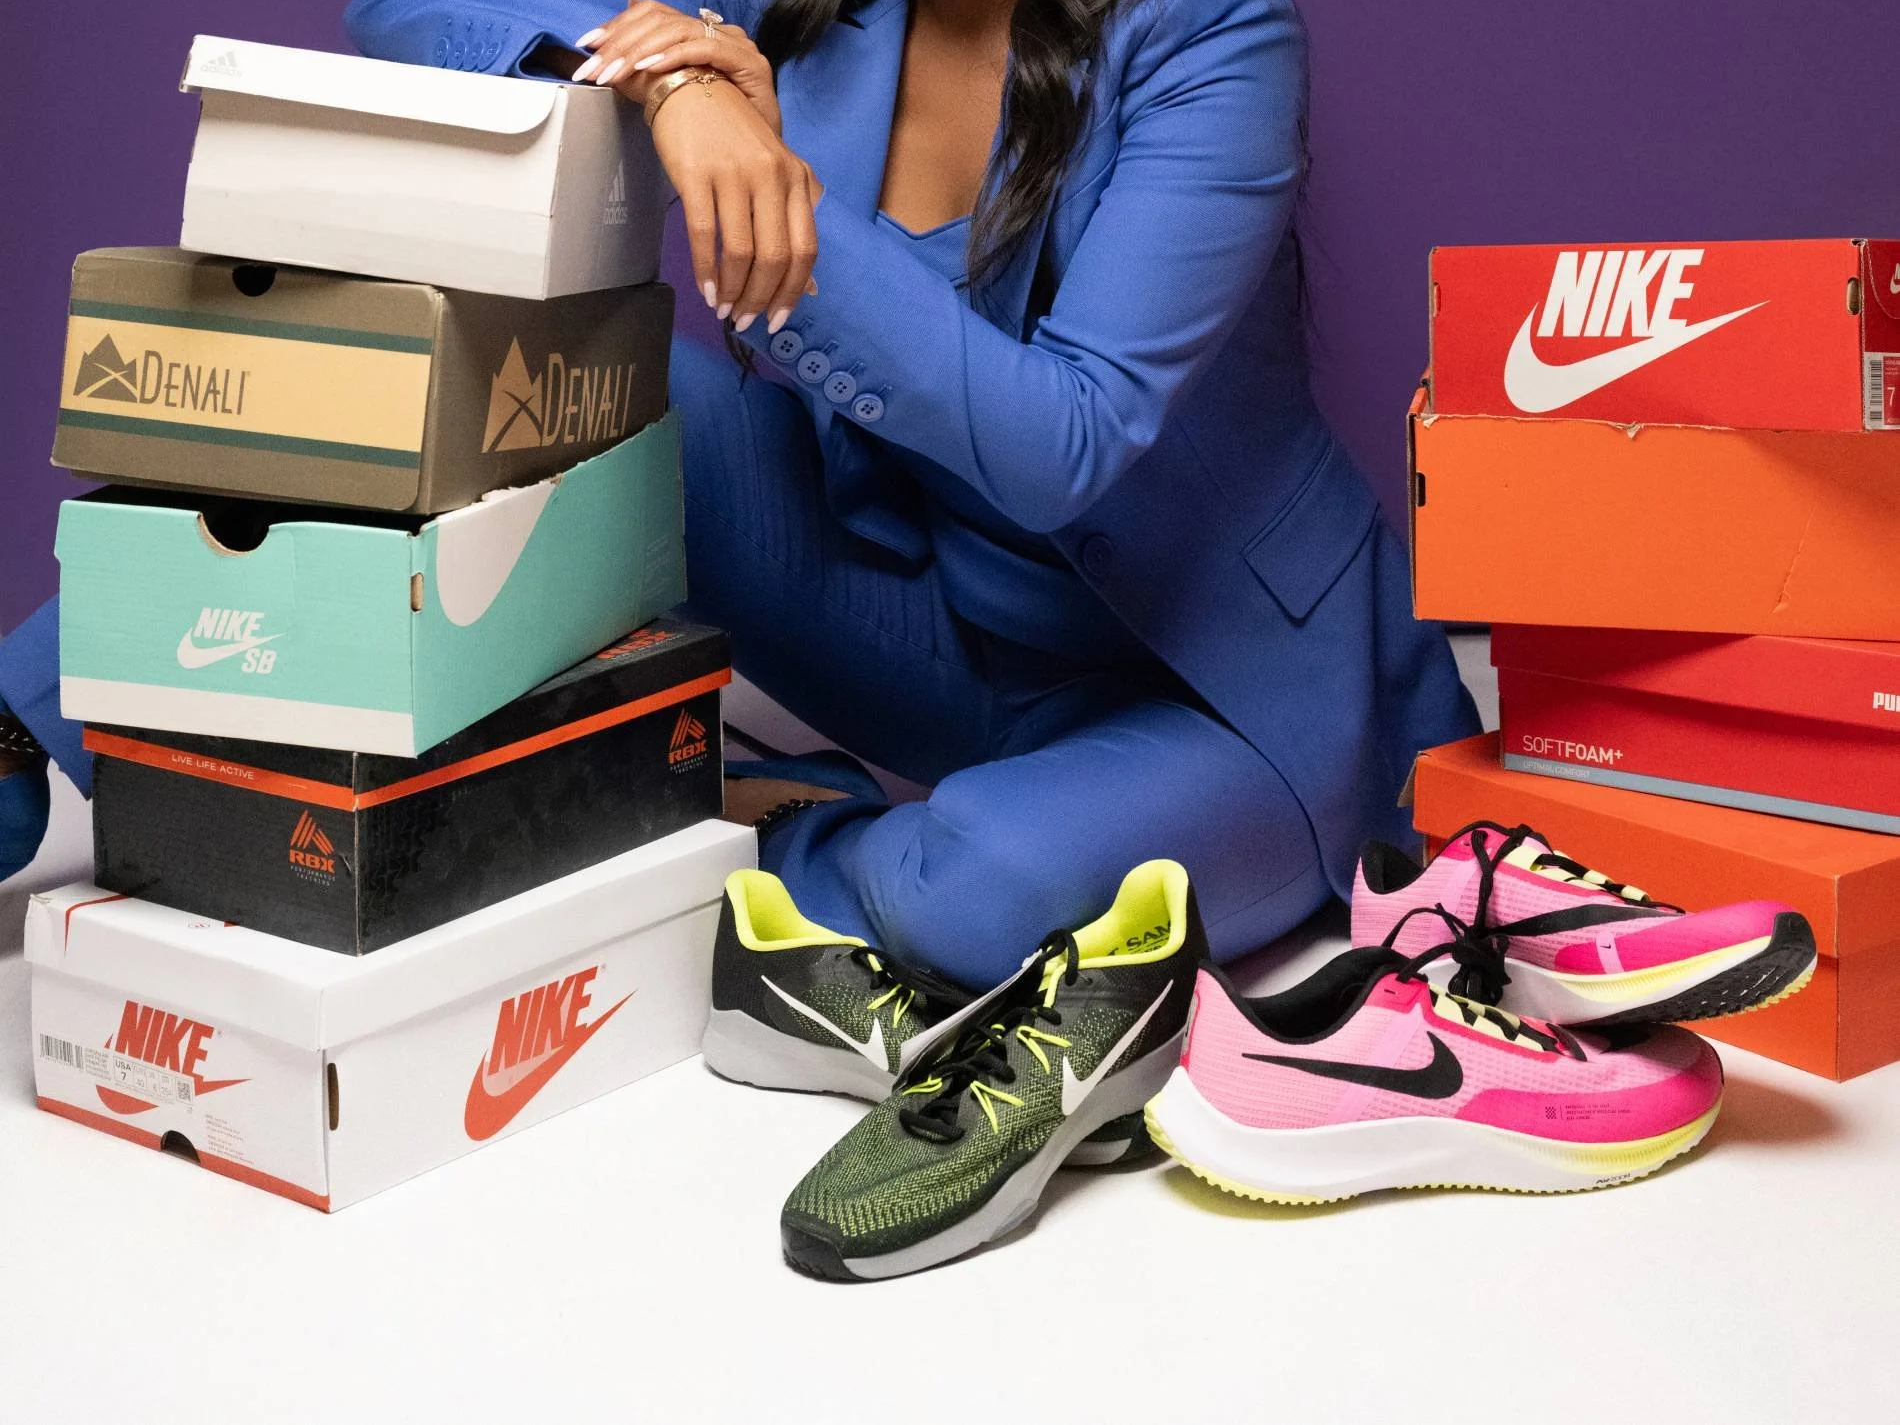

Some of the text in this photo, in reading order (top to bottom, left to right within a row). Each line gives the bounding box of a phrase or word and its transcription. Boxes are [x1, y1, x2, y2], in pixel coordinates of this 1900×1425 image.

[1537, 249, 1705, 338] NIKE
[139, 349, 247, 416] DENALI
[541, 352, 634, 448] DENALI
[1887, 386, 1896, 407] 7
[193, 607, 265, 643] NIKE
[241, 648, 278, 674] SB
[1872, 691, 1900, 713] PU
[668, 741, 707, 765] RBX
[1522, 734, 1624, 766] SOFTFOAM+
[171, 754, 255, 780] LIVE LIFE ACTIVE
[289, 849, 336, 874] RBX
[488, 965, 599, 1077] NIKE
[114, 999, 215, 1081] NIKE
[114, 1059, 132, 1073] USA
[121, 1072, 127, 1081] 7
